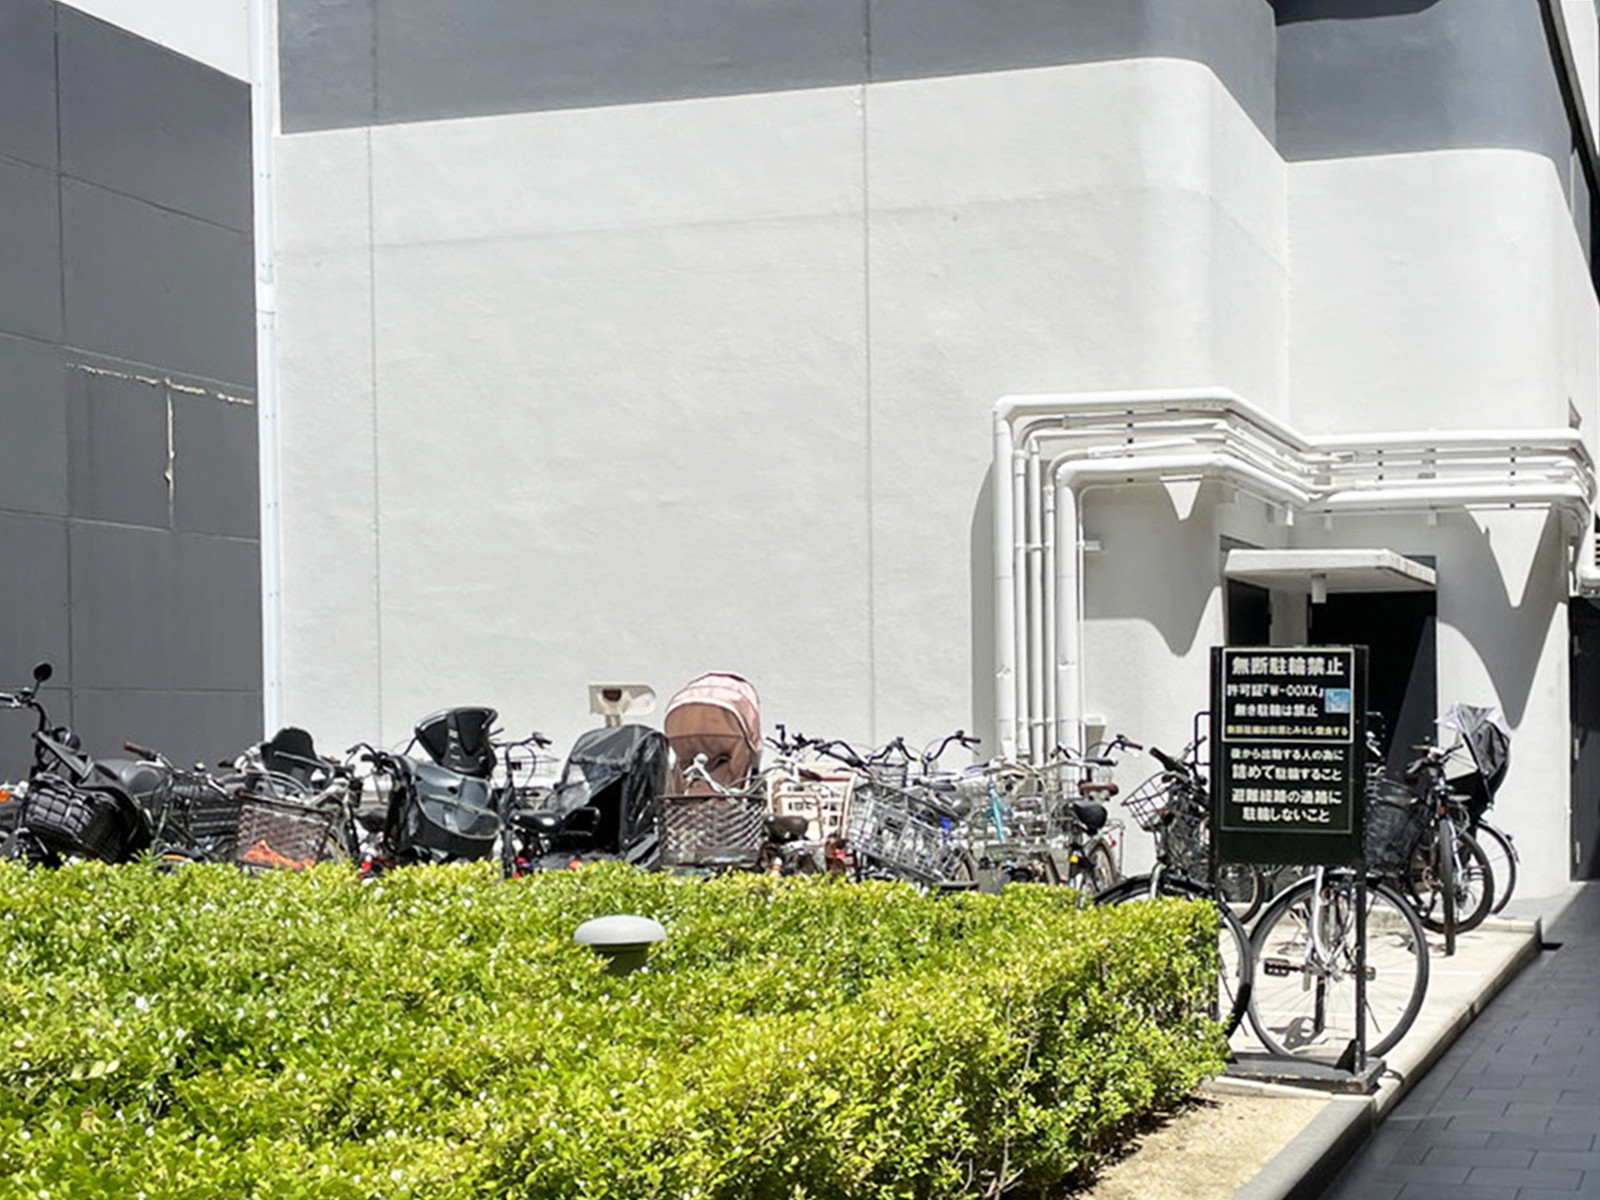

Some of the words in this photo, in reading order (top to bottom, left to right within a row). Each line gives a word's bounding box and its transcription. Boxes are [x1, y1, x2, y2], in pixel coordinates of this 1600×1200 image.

[1232, 656, 1344, 675] 無断駐輪禁止
[1234, 703, 1319, 717] 無き駐輪は禁止
[1232, 764, 1342, 781] 詰めて駐輪すること
[1242, 806, 1330, 823] 駐輪しないこと
